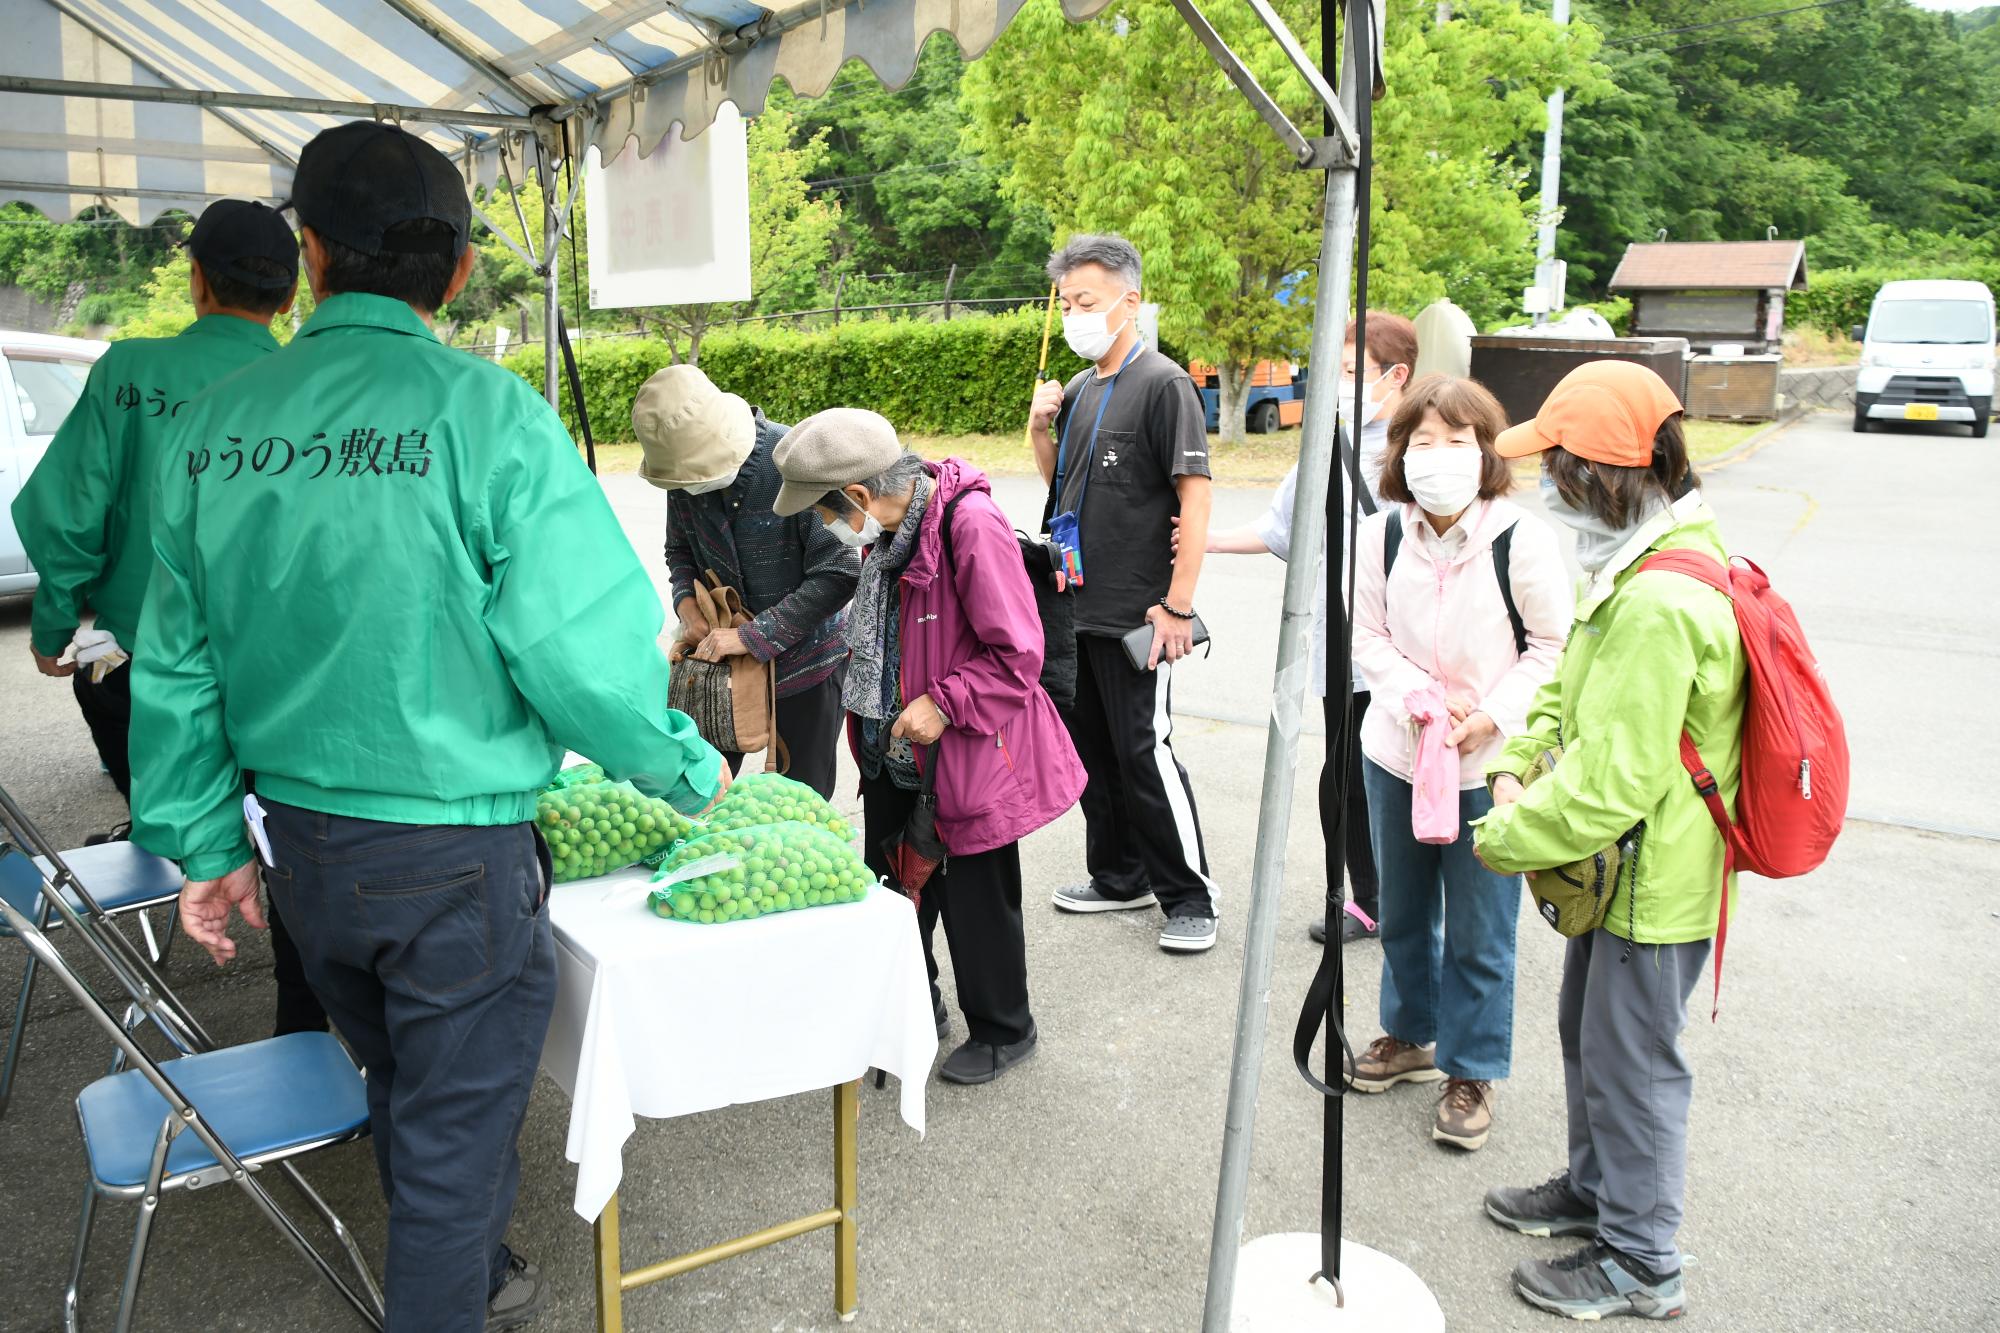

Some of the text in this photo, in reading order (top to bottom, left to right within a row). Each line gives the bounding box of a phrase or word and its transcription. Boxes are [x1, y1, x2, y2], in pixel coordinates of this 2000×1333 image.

[186, 427, 433, 486] ゆうのう敷島
